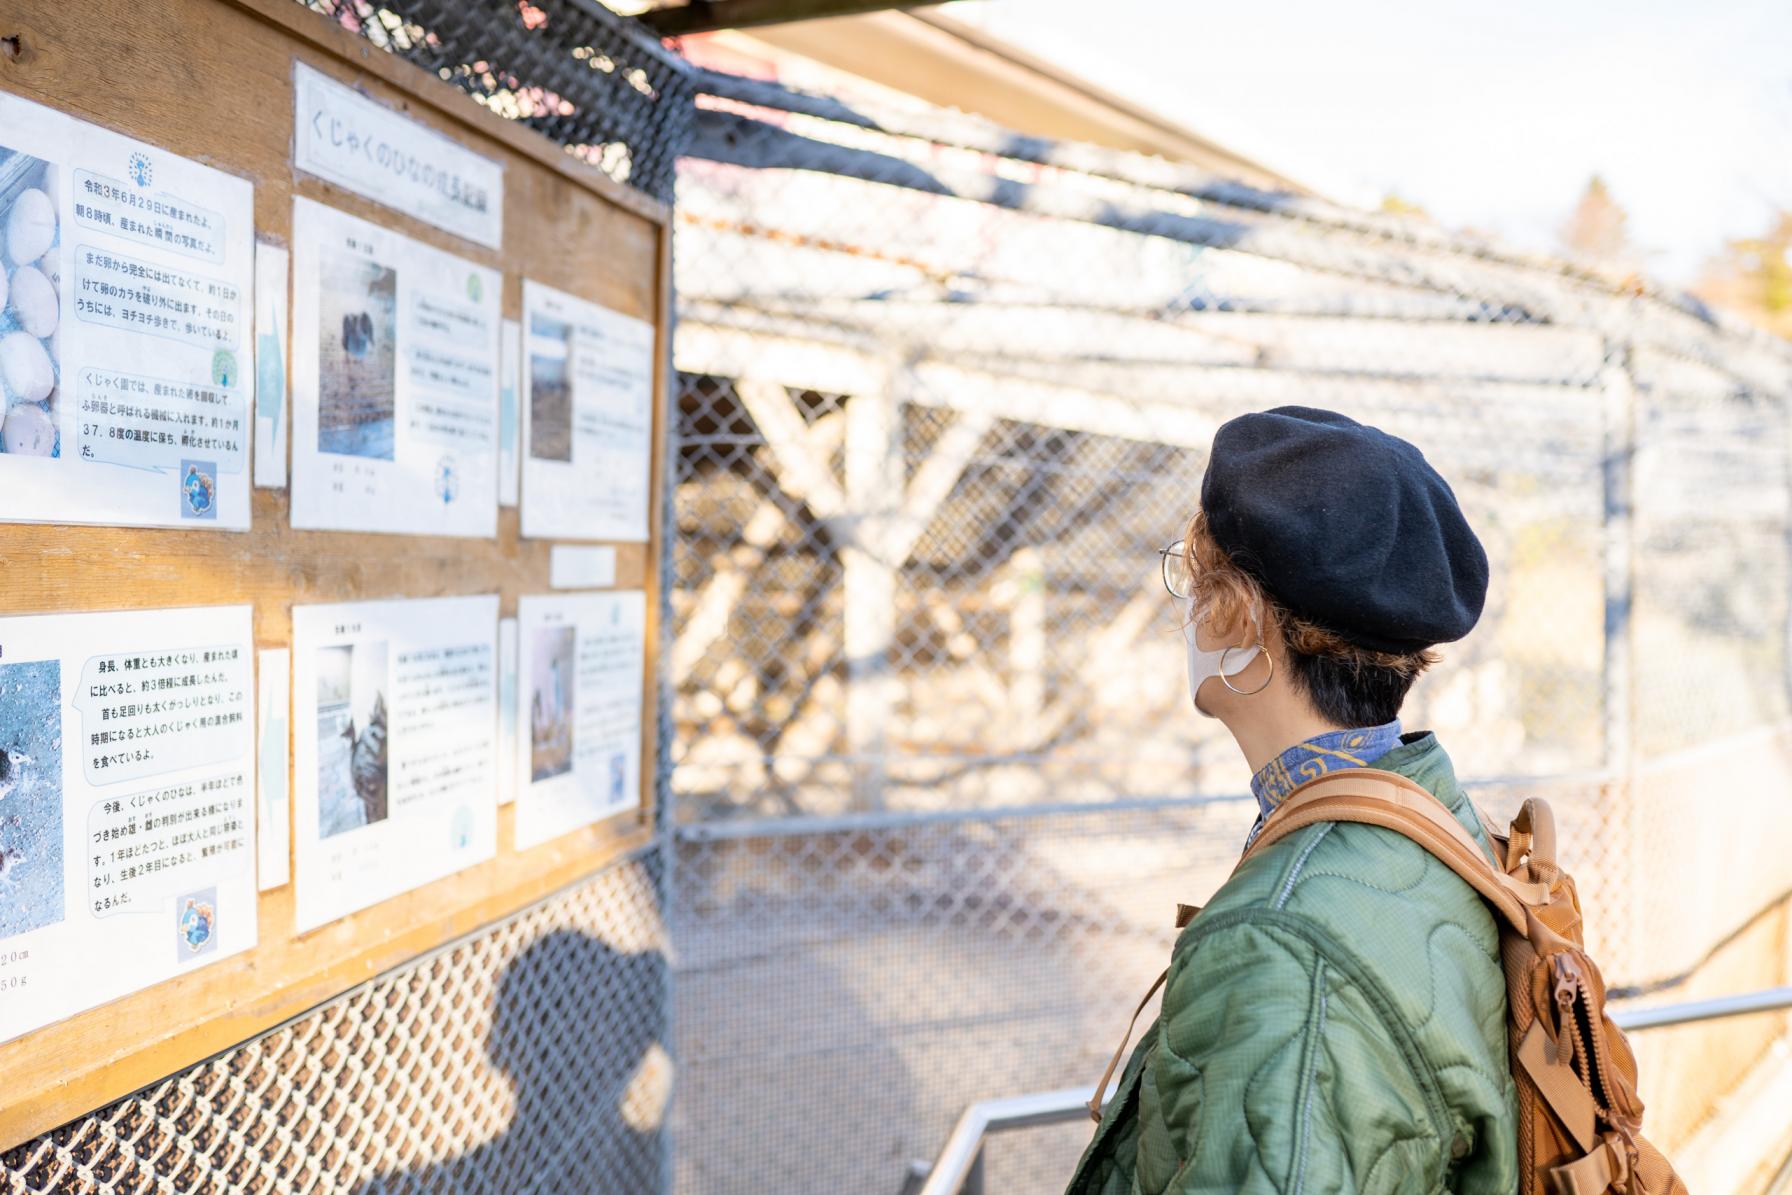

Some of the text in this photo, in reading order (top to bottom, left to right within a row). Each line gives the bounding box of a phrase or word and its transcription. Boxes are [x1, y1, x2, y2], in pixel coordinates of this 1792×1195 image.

[82, 445, 95, 457] だ。
[93, 749, 154, 769] を食べているよ。
[94, 893, 132, 912] なるんだ。
